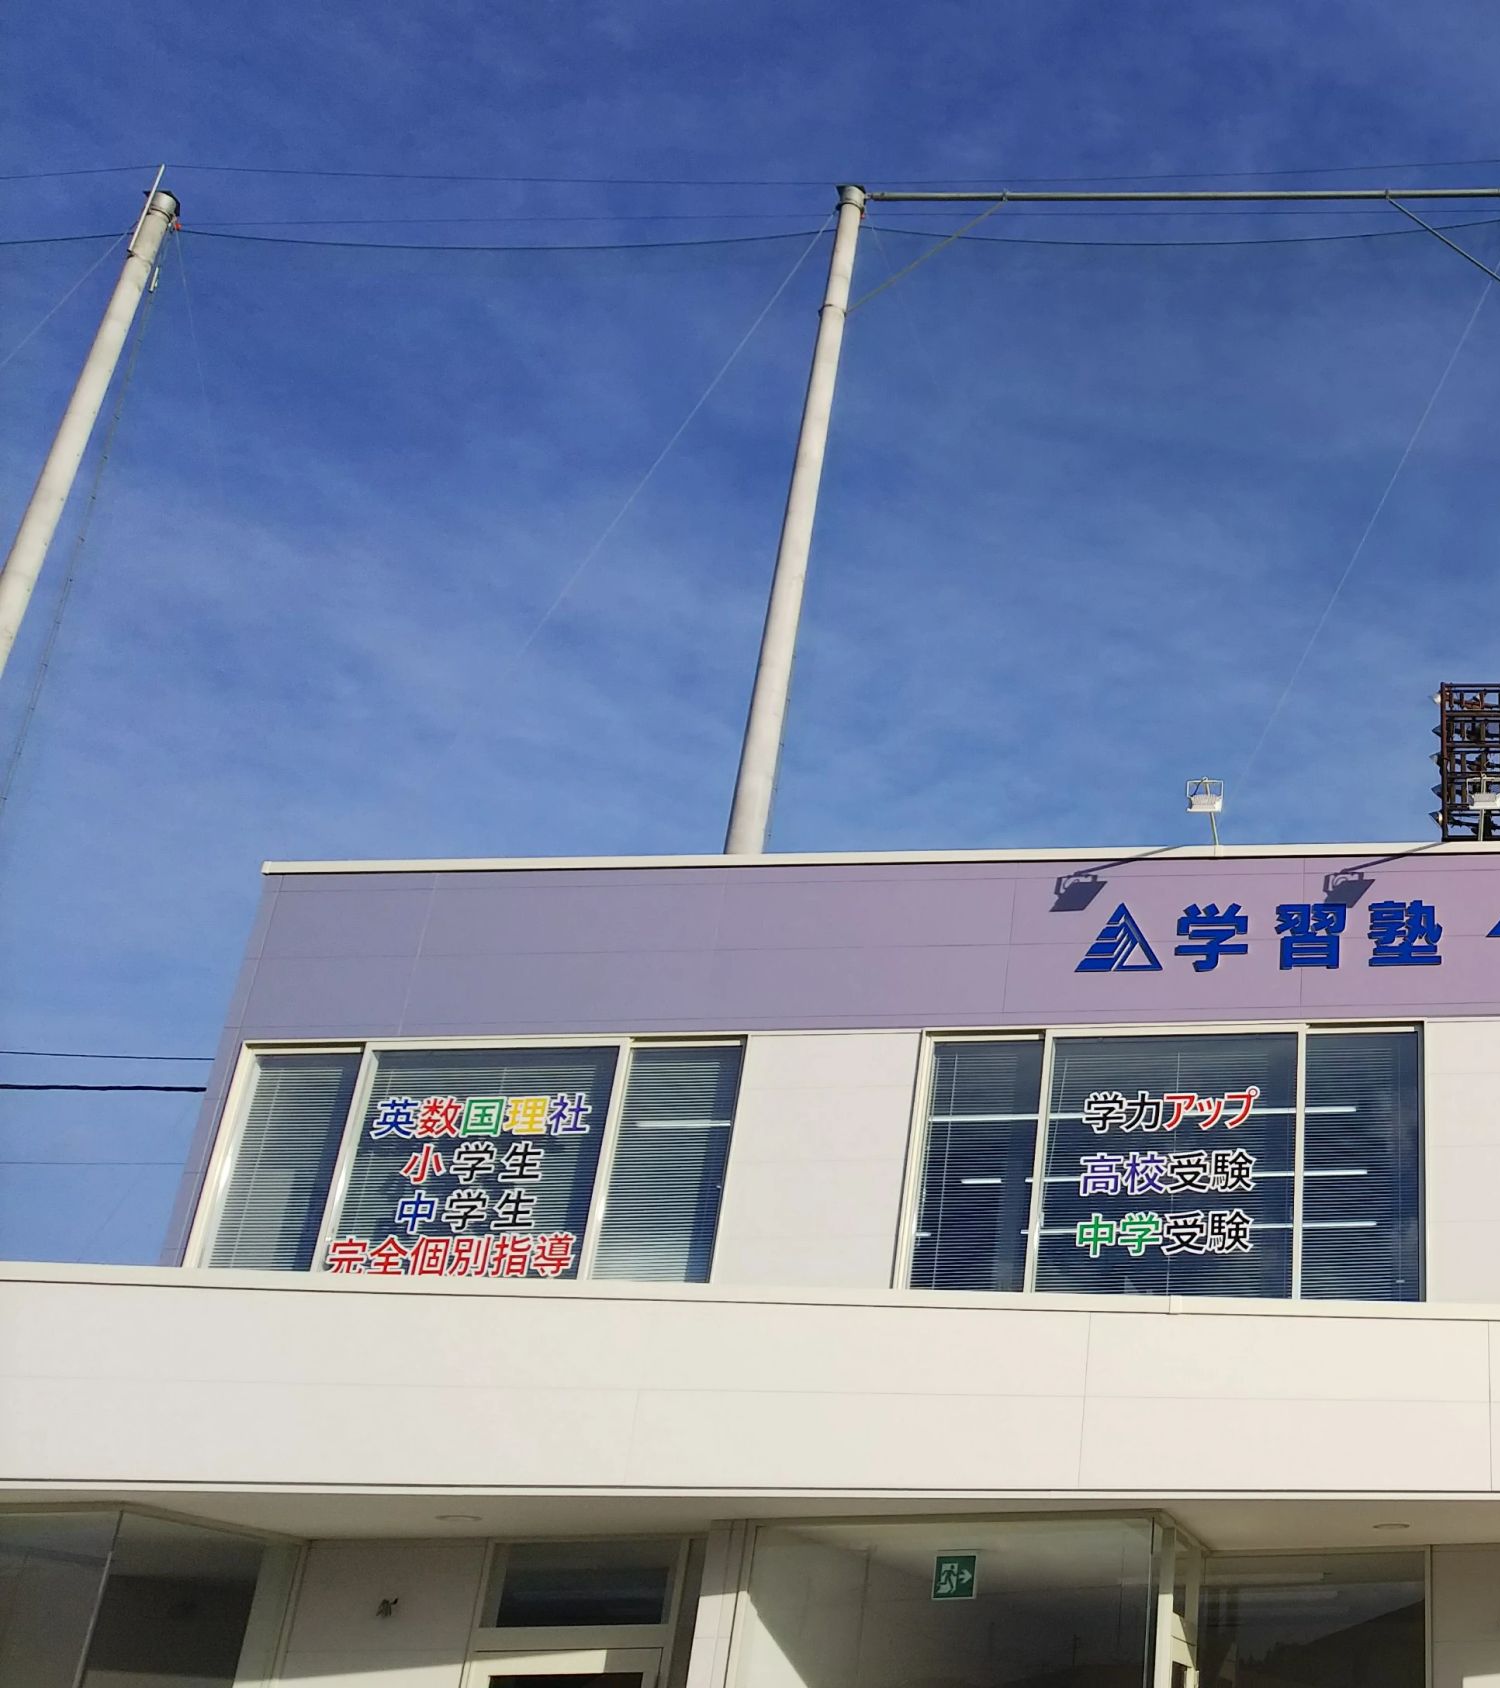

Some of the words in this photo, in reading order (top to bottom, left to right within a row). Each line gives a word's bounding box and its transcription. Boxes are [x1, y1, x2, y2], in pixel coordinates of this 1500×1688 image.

[1174, 901, 1443, 972] 学習塾
[370, 1092, 592, 1138] 英数国理社
[1082, 1086, 1260, 1133] 学力アップ
[400, 1141, 542, 1184] 小学生
[1080, 1148, 1257, 1196] 高校受験
[395, 1189, 537, 1233] 中学生
[1076, 1209, 1253, 1258] 中学受験
[325, 1233, 576, 1276] 完全個別指導
